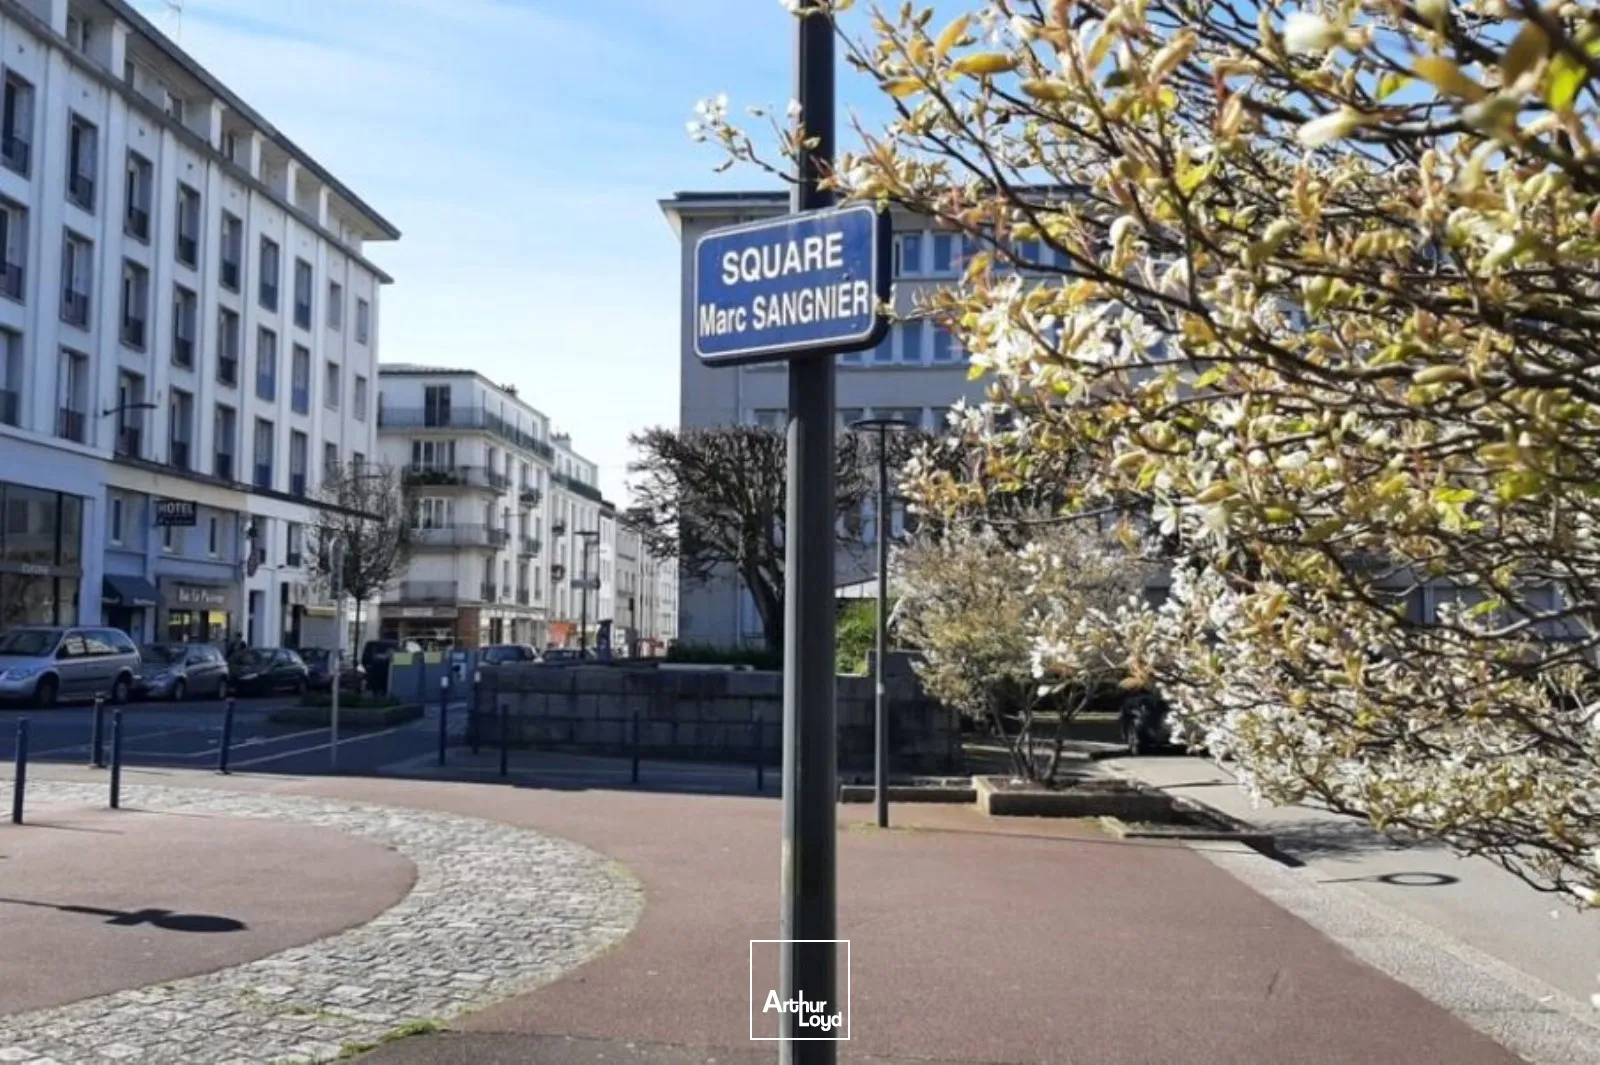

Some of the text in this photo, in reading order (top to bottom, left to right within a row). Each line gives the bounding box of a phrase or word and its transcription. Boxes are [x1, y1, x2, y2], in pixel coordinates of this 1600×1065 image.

[722, 232, 844, 285] SQUARE
[700, 280, 868, 337] Marc SANGNIER
